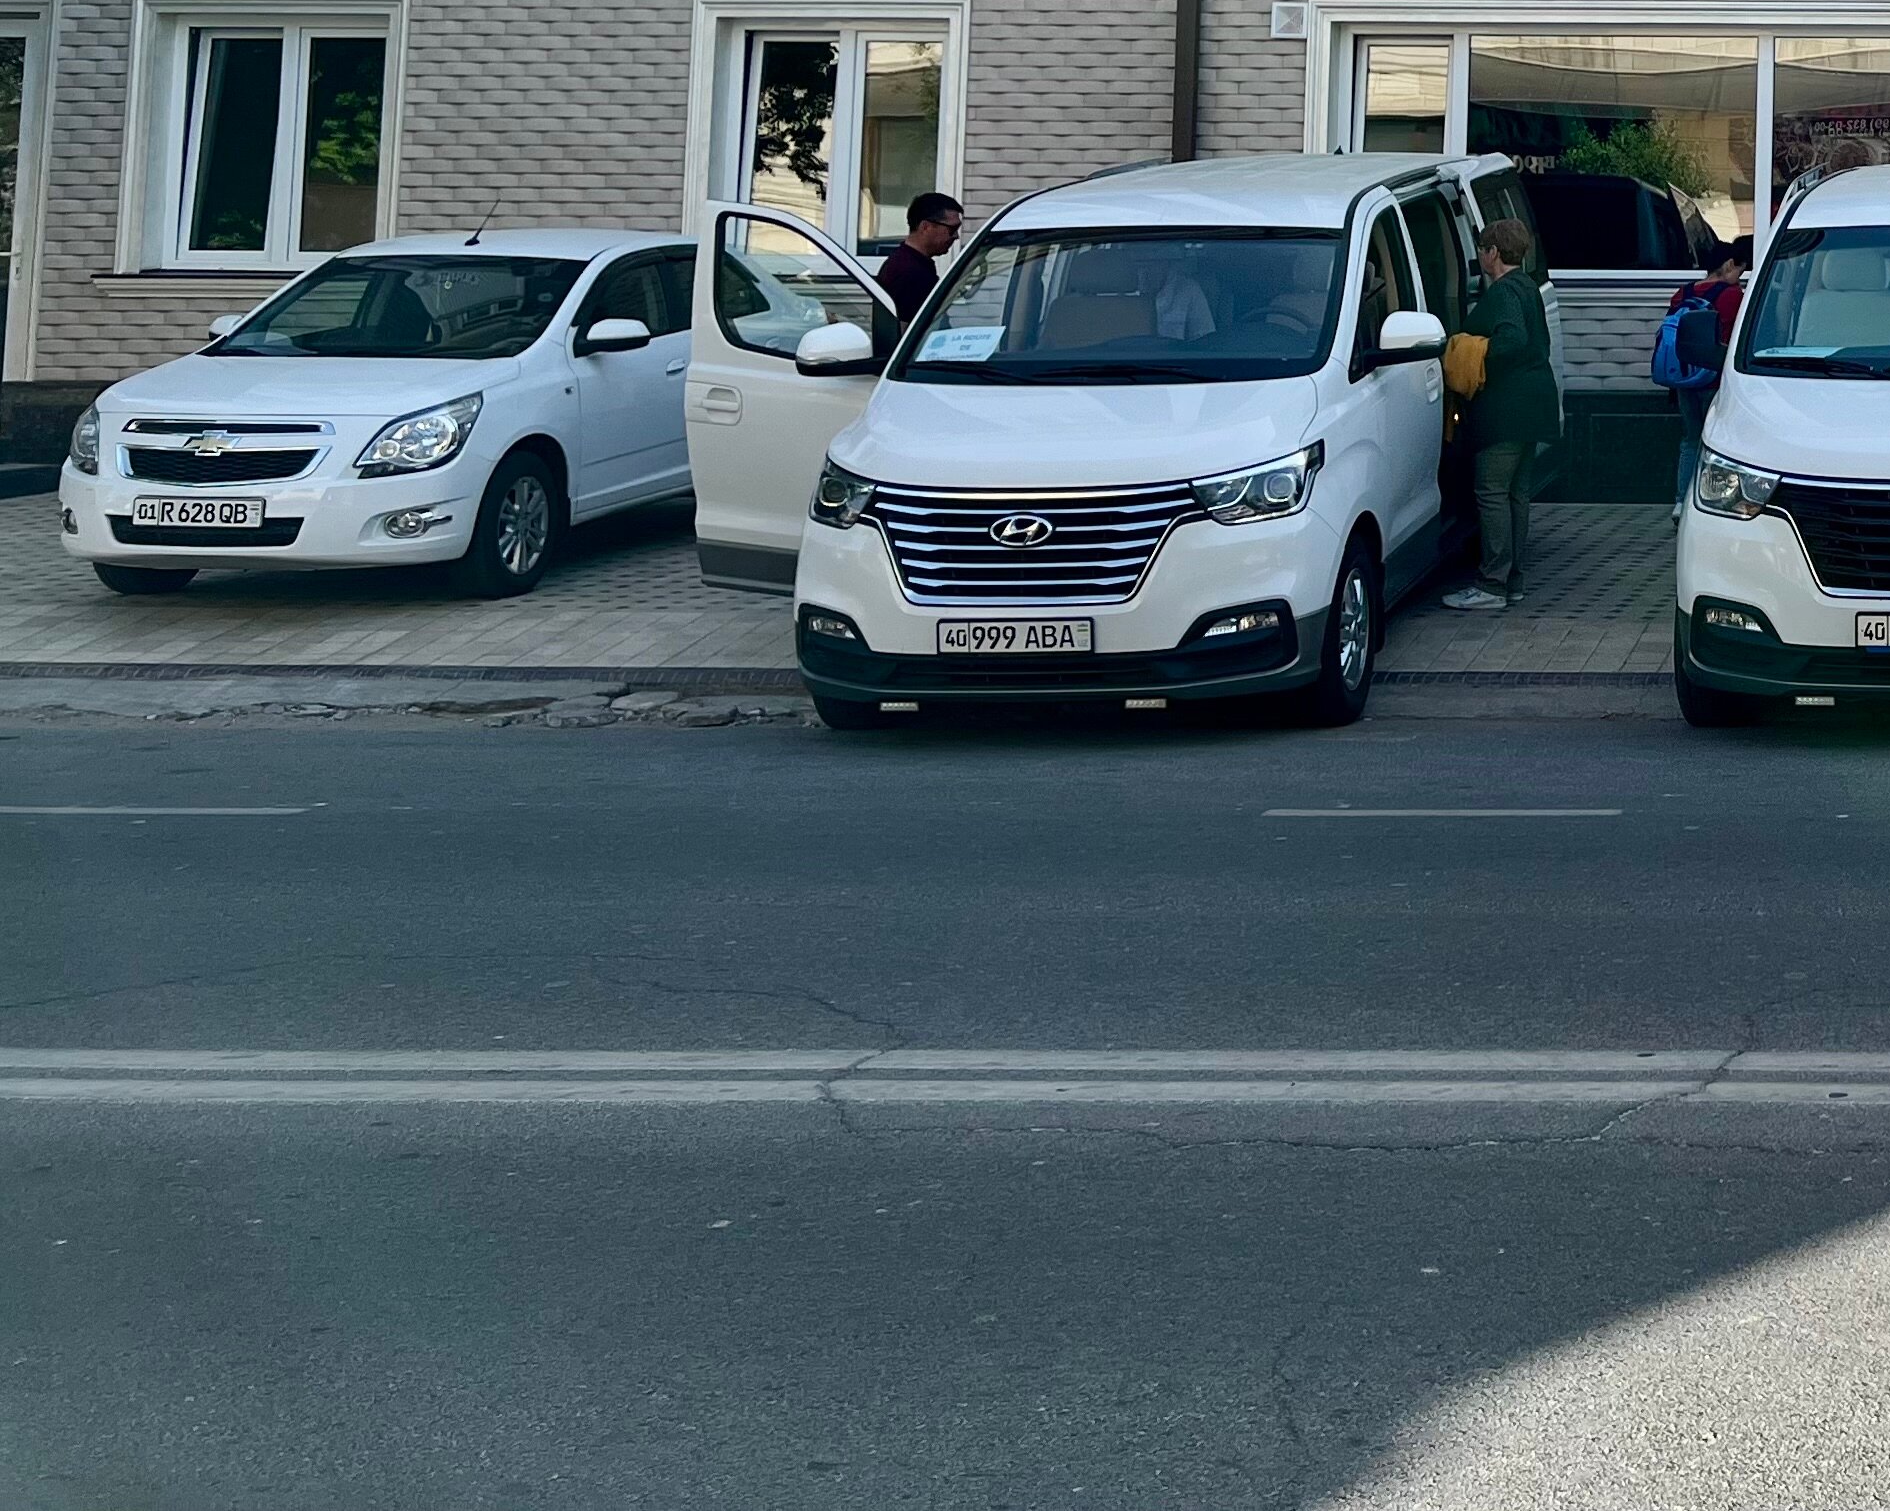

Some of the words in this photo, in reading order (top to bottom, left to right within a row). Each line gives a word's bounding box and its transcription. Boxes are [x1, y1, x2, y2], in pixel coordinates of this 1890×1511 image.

[138, 503, 157, 520] 01
[160, 501, 175, 523] R
[178, 502, 216, 523] 628
[219, 502, 249, 524] QB
[945, 628, 967, 647] 40
[972, 625, 1017, 650] 999
[1024, 624, 1075, 650] ABA
[1863, 621, 1886, 641] 40
